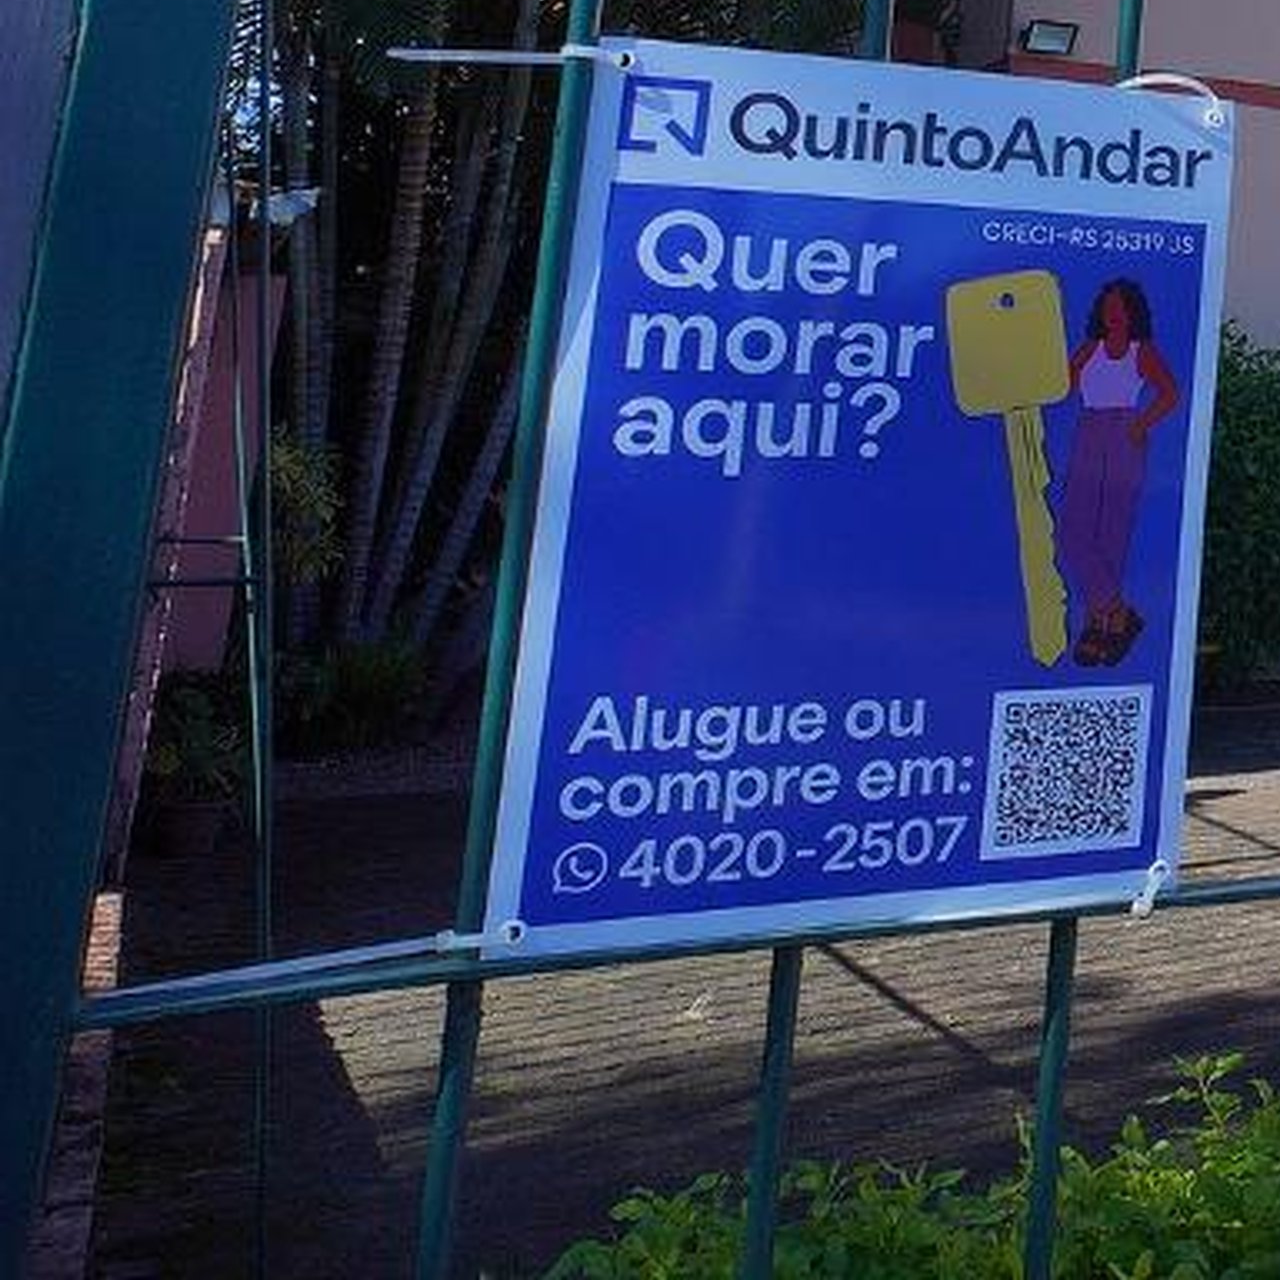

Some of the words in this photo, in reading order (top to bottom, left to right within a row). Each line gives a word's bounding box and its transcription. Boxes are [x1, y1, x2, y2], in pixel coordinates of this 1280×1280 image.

[729, 92, 1213, 189] QuintoAndar
[636, 209, 898, 295] Quer
[625, 313, 935, 377] morar
[612, 381, 901, 477] aqui?
[568, 695, 827, 761] Alugue
[844, 698, 926, 740] ou
[559, 763, 841, 824] compre
[856, 756, 974, 801] em:
[618, 815, 969, 888] 4020-2507
